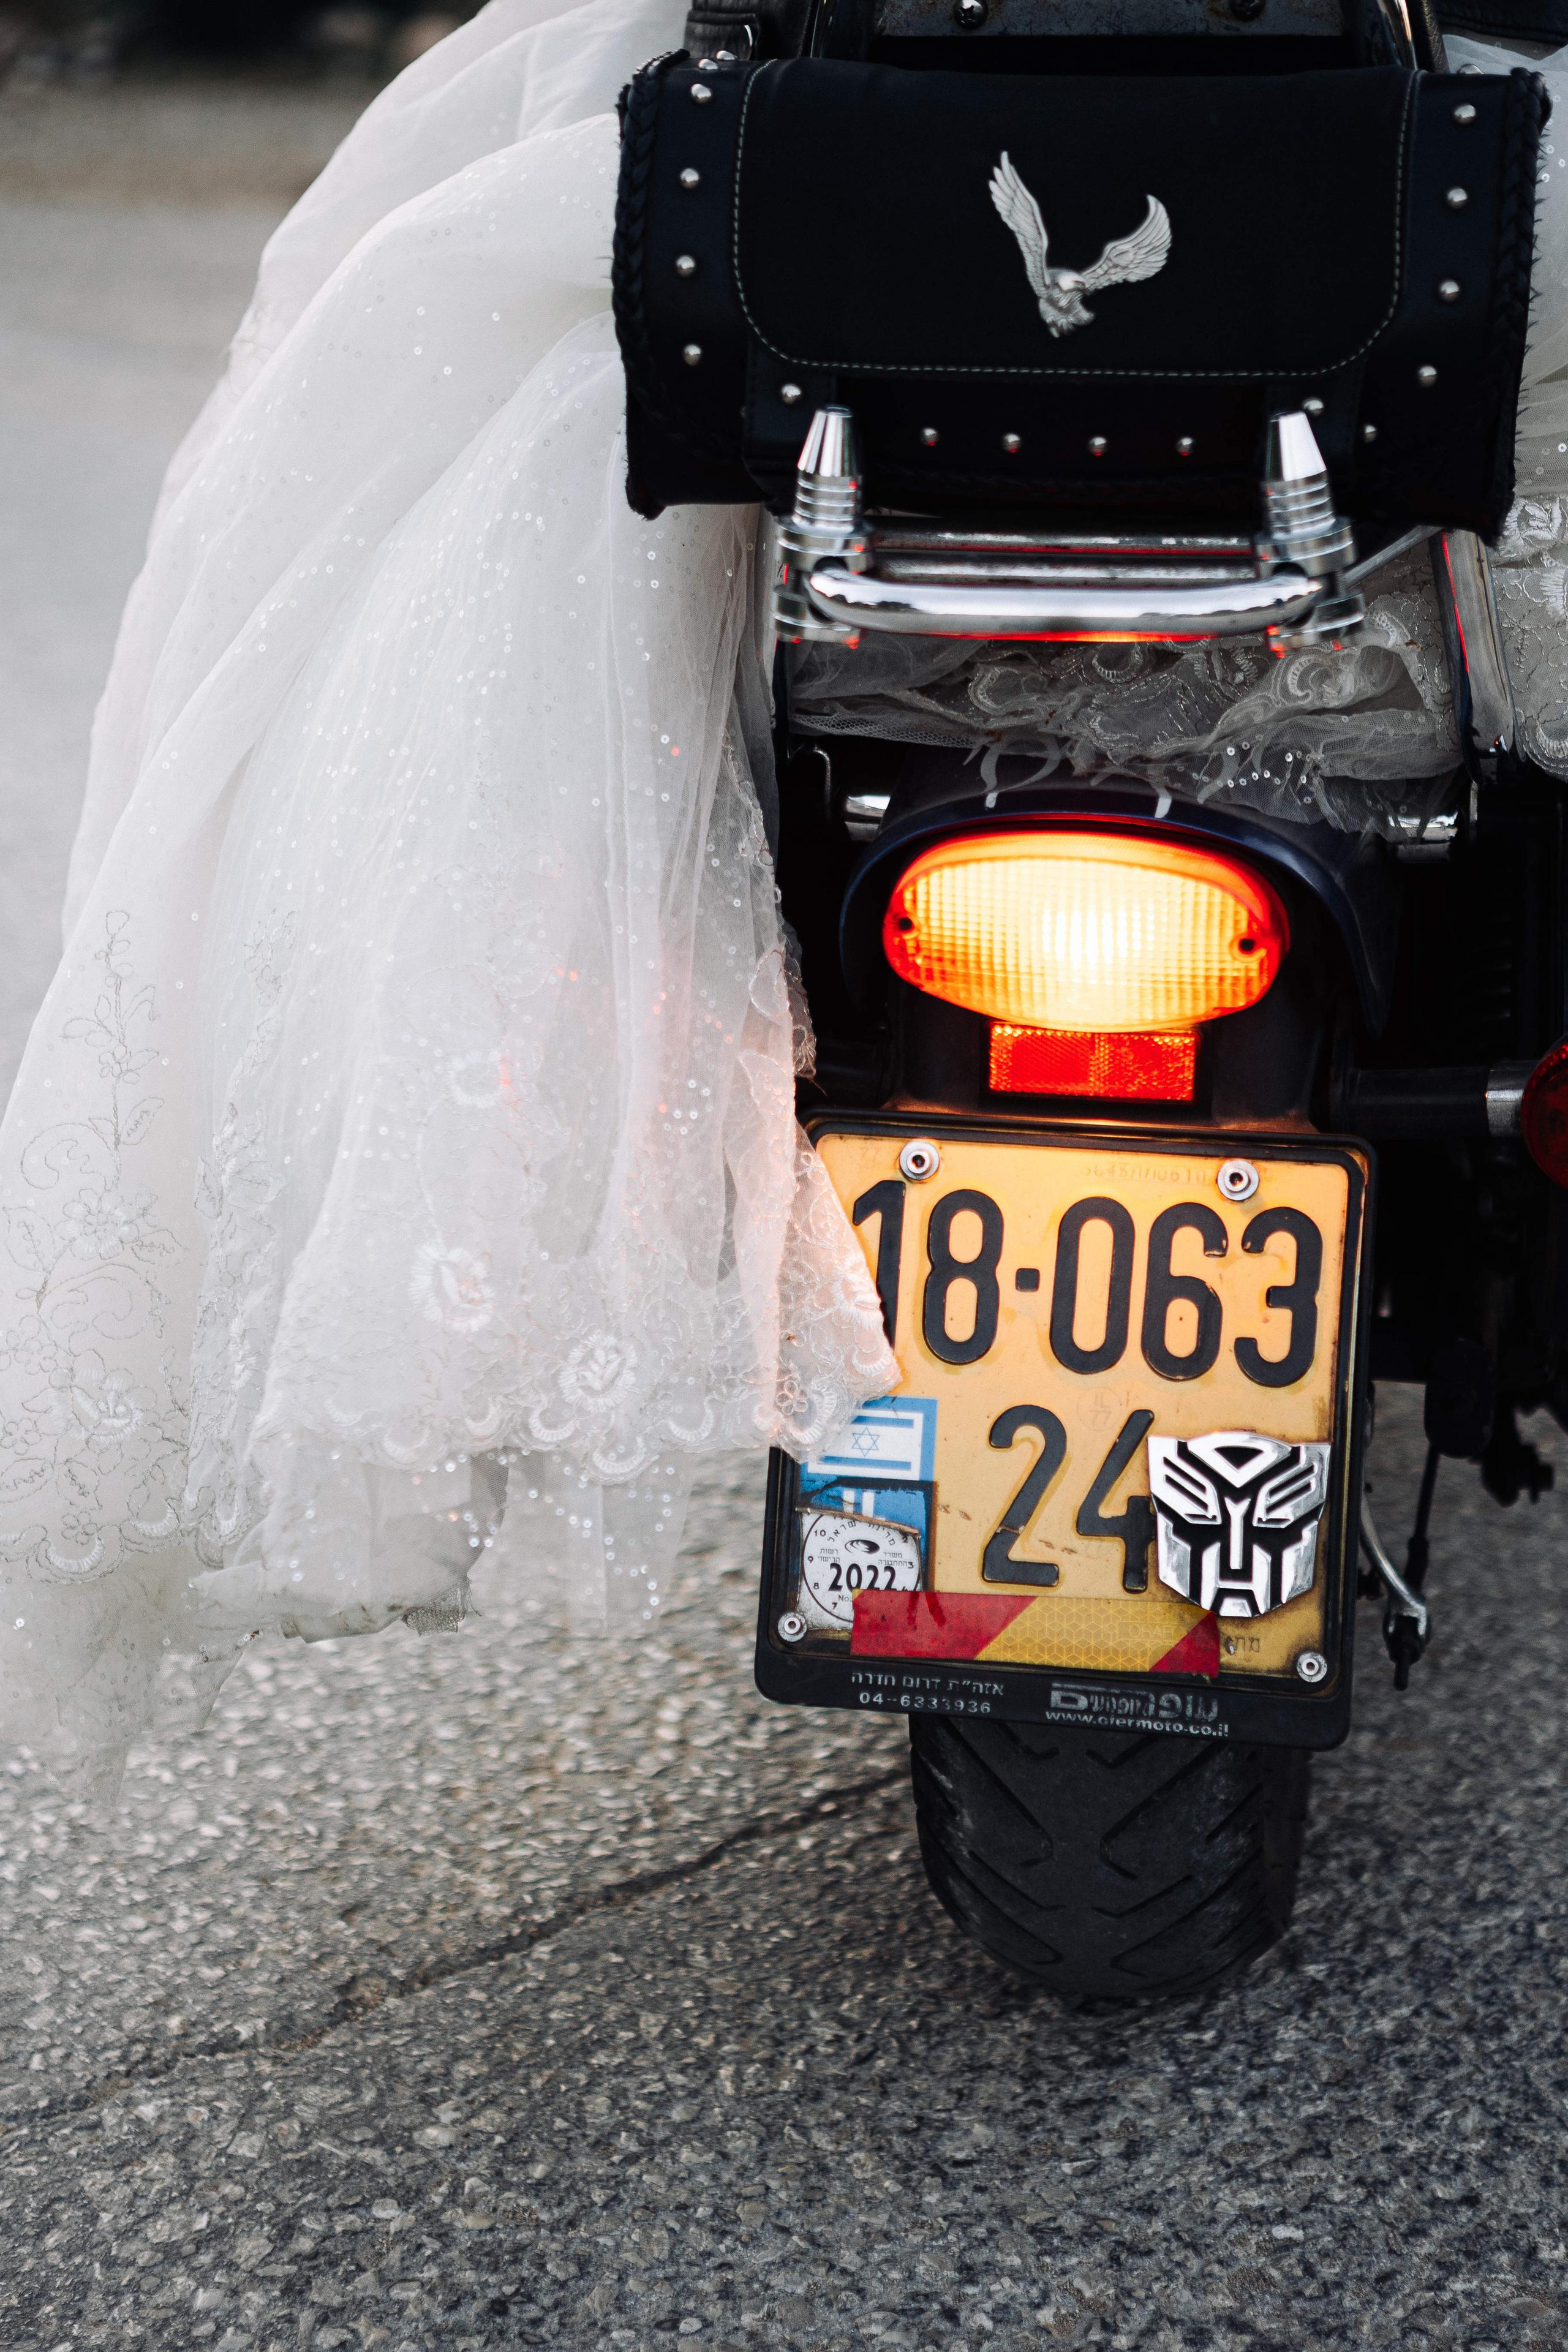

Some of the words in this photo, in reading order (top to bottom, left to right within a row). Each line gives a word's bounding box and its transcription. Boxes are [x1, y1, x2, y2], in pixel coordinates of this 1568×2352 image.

[853, 1180, 1323, 1387] 18-063
[981, 1404, 1159, 1594] 24
[827, 1520, 856, 1542] שראל
[828, 1562, 897, 1593] 2022
[832, 1602, 837, 1610] 7
[851, 1672, 895, 1686] חדרה
[902, 1676, 941, 1690] דרום
